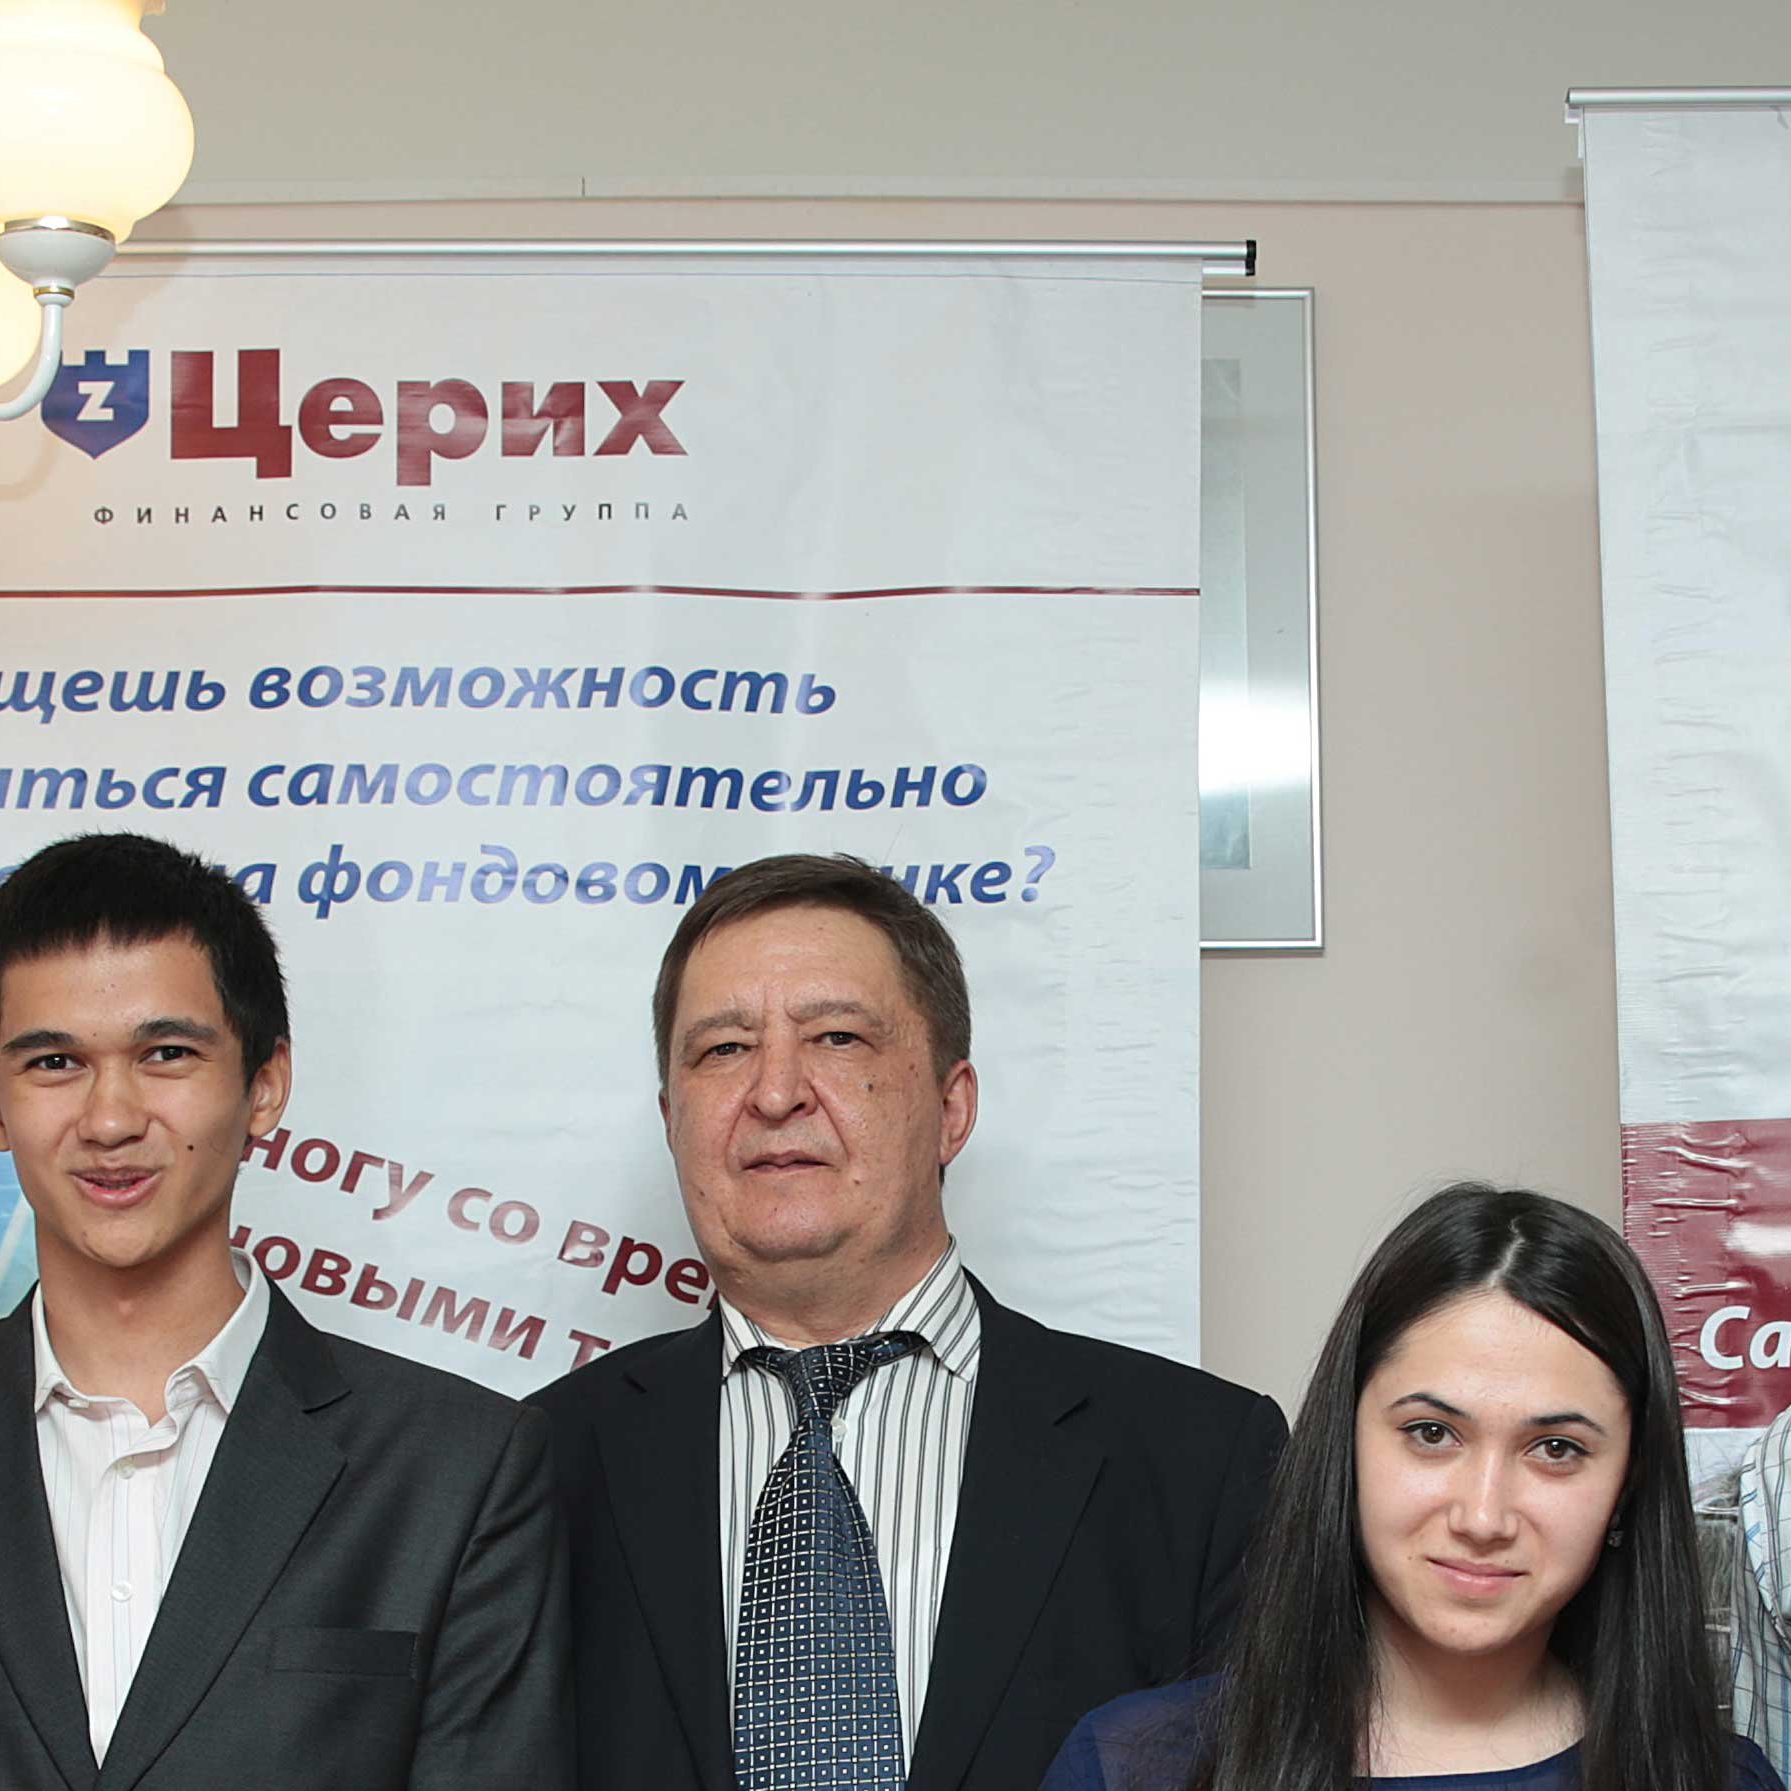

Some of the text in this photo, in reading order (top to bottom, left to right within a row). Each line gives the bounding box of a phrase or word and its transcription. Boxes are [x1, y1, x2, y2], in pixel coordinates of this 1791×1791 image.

[170, 348, 689, 487] Церих
[93, 503, 688, 524] ФИНАНСОВАЯ ГРУППА
[249, 664, 837, 715] возможность
[246, 761, 988, 812] самостоятельно
[297, 844, 726, 920] фондовом
[446, 1187, 541, 1246] со
[556, 1219, 719, 1312] вре
[231, 1224, 547, 1360] овыми
